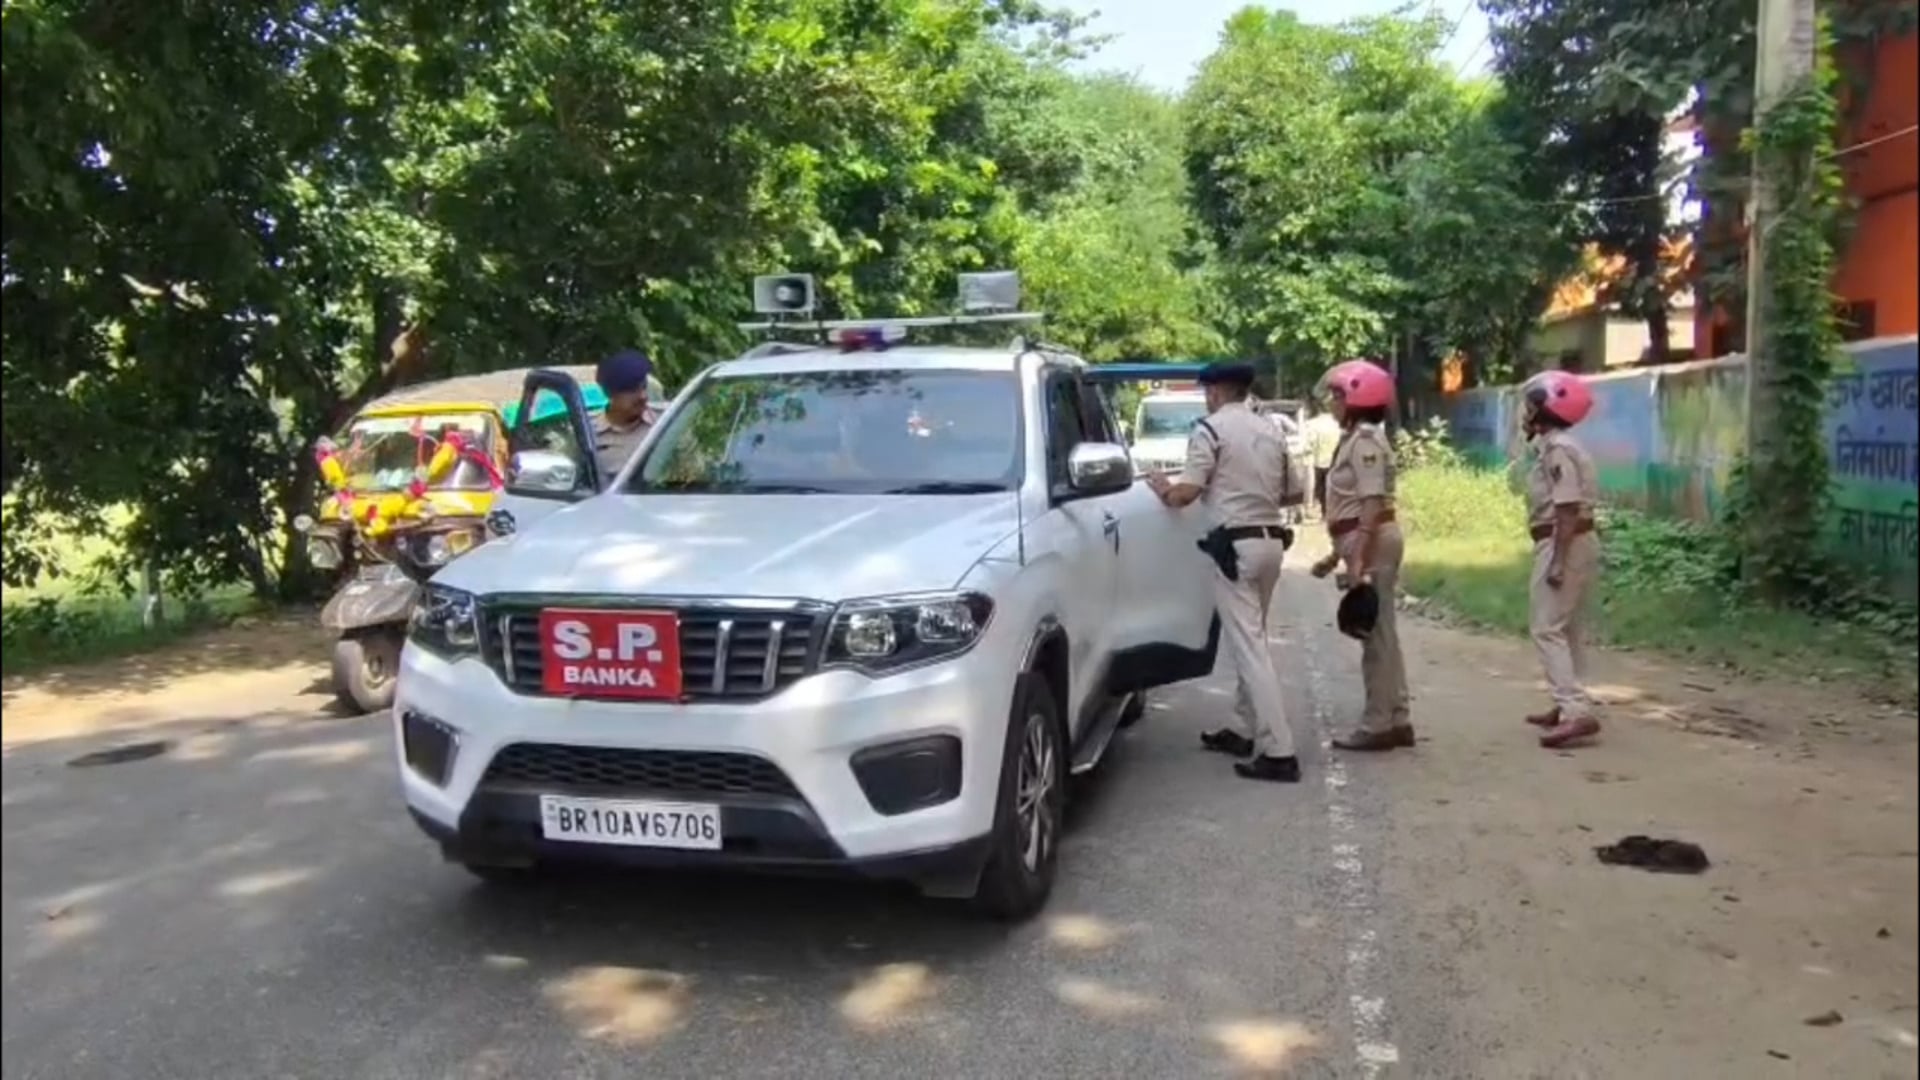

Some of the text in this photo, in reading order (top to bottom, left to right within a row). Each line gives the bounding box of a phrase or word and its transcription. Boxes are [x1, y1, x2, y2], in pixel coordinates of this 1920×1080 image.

[553, 620, 662, 662] S.P.
[563, 665, 656, 688] BANKA
[559, 806, 715, 840] BR10AV6706
